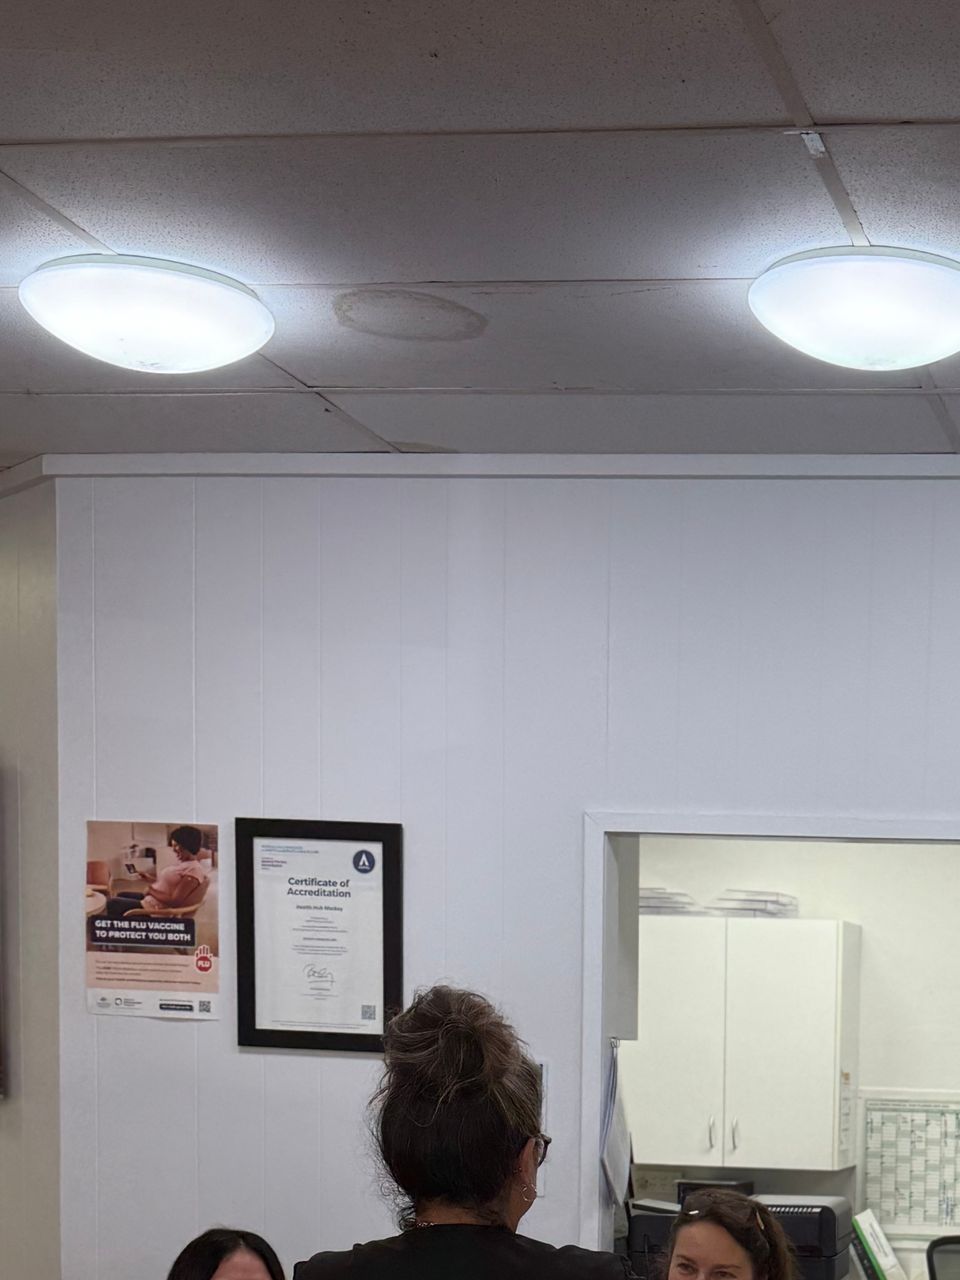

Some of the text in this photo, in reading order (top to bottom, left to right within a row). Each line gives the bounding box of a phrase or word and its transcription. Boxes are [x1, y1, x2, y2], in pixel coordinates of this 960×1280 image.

[288, 877, 350, 888] Certificate of
[287, 887, 351, 898] Accreditation
[95, 919, 184, 930] GET THE FLU VACCINE
[95, 930, 191, 941] TO PROTECT YOU BOTH
